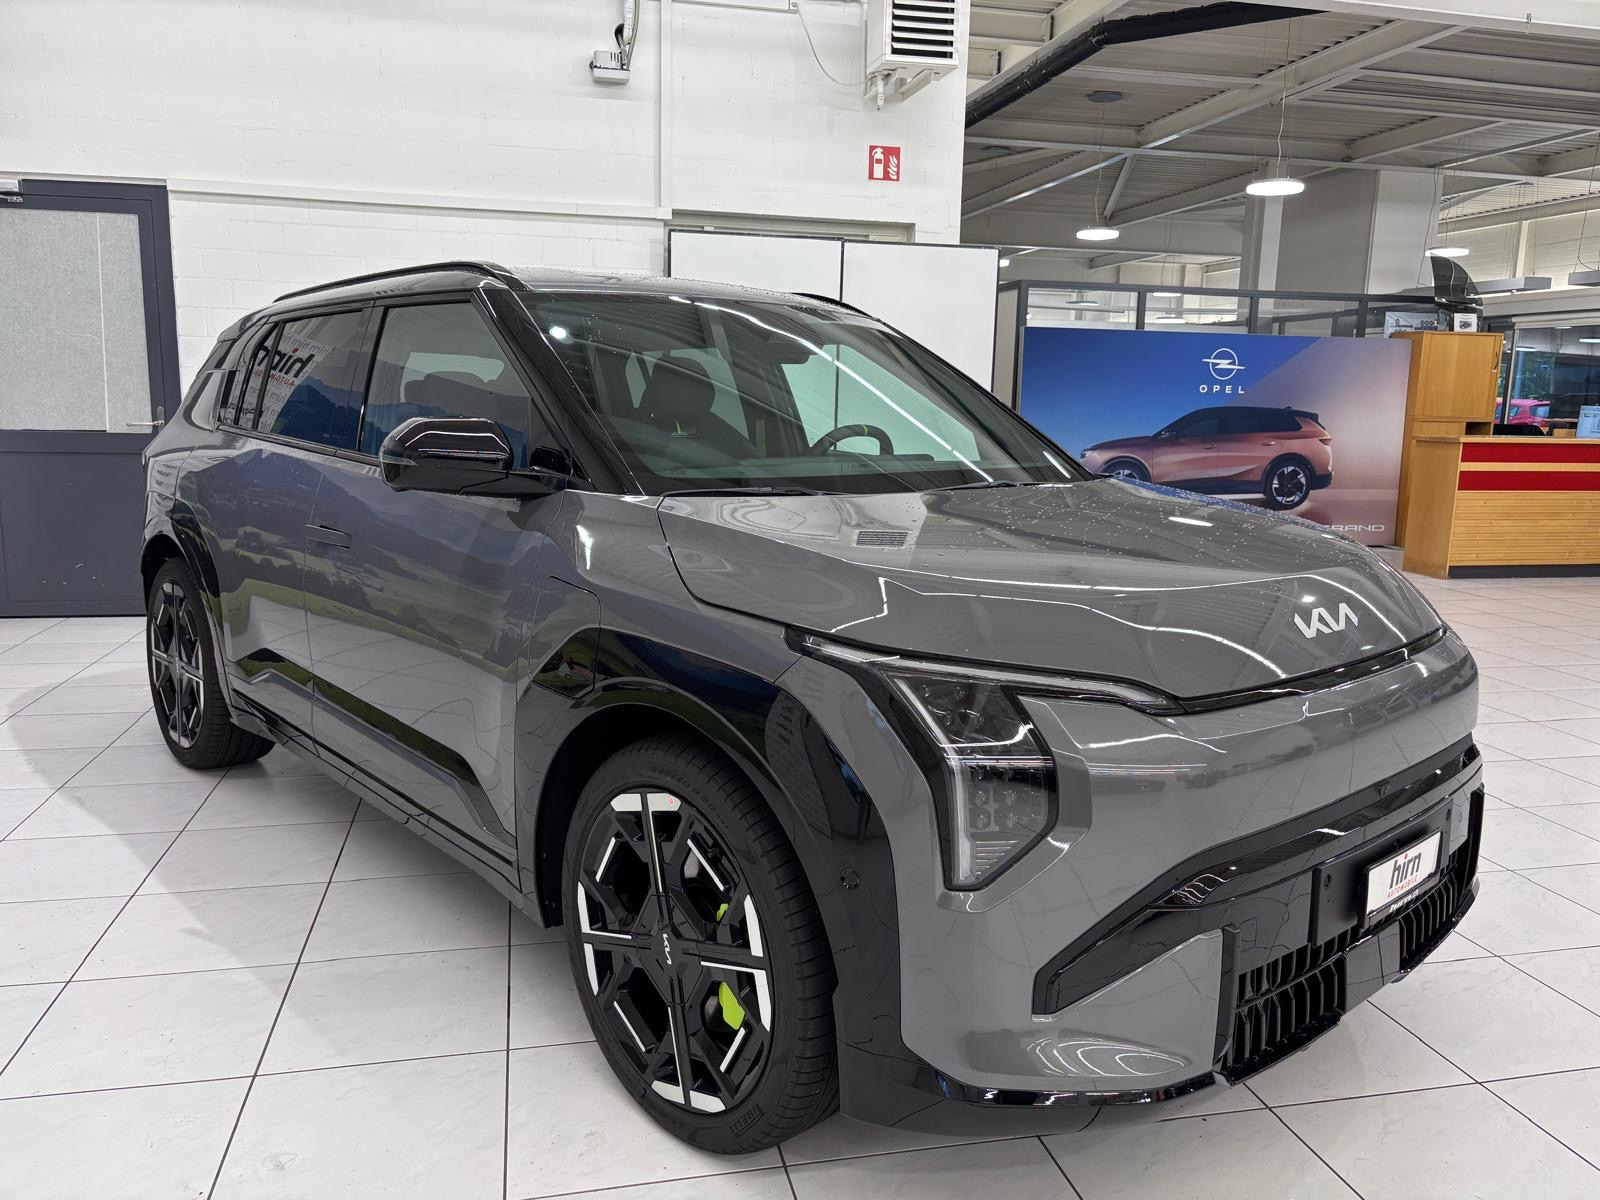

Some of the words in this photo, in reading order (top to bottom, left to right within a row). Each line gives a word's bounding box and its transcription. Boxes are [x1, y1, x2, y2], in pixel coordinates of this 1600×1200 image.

[1199, 384, 1245, 394] OPEL
[1323, 524, 1385, 532] RAND
[1293, 602, 1359, 639] KIA
[1388, 852, 1422, 890] hirn
